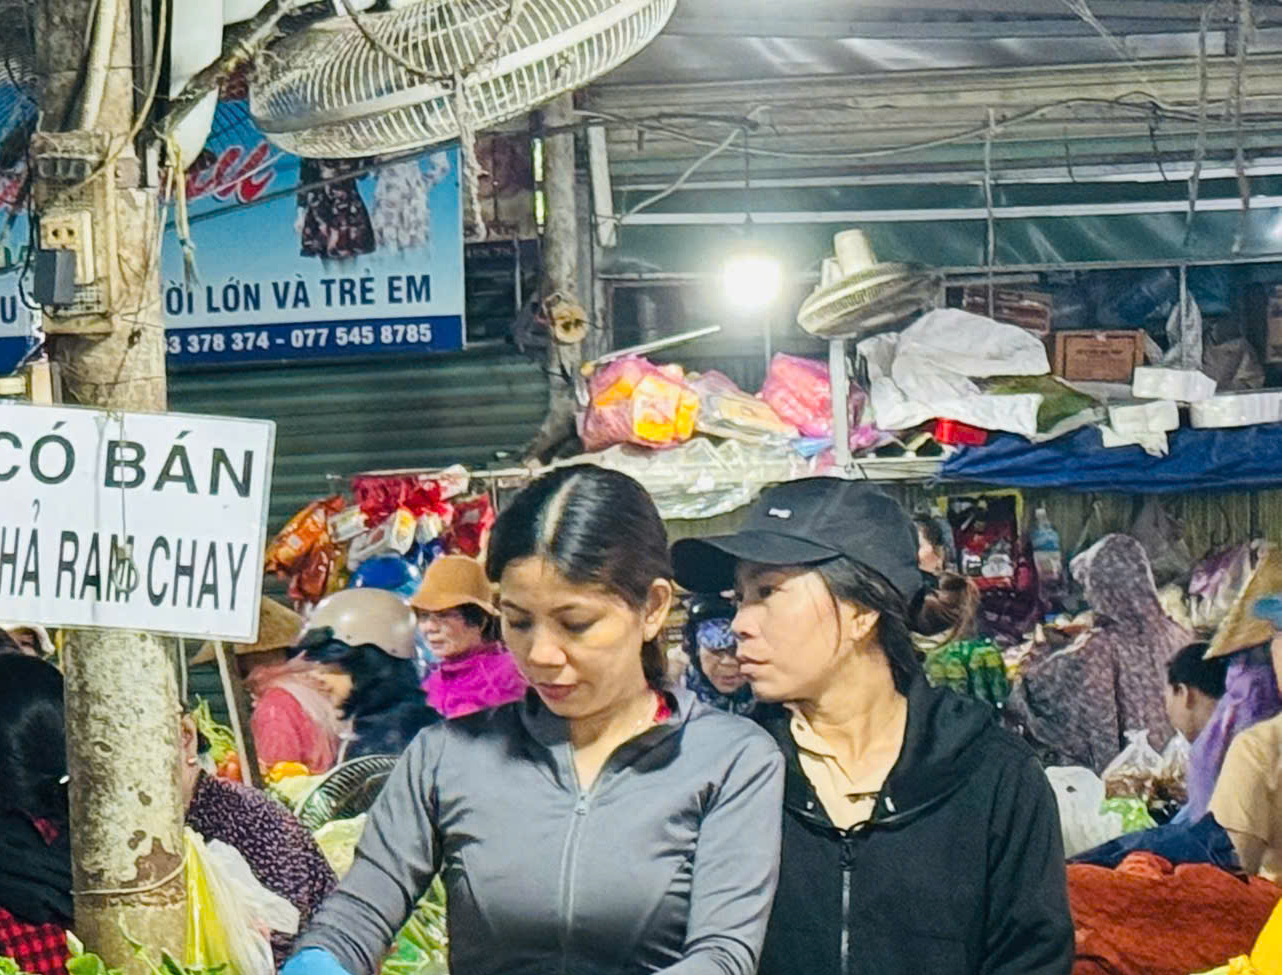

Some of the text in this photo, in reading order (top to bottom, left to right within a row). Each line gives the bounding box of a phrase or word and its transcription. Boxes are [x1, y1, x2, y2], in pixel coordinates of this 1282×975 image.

[206, 276, 261, 313] LỚN
[271, 273, 310, 309] VÀ
[320, 268, 375, 307] TRẺ
[388, 274, 431, 304] EM
[187, 333, 225, 353] 378
[231, 331, 270, 351] 374
[291, 328, 329, 348] 077
[335, 326, 374, 346] 545
[380, 323, 432, 344] 8785
[104, 430, 254, 498] BÁN
[55, 530, 135, 603] RAM
[147, 535, 248, 611] CHAY
